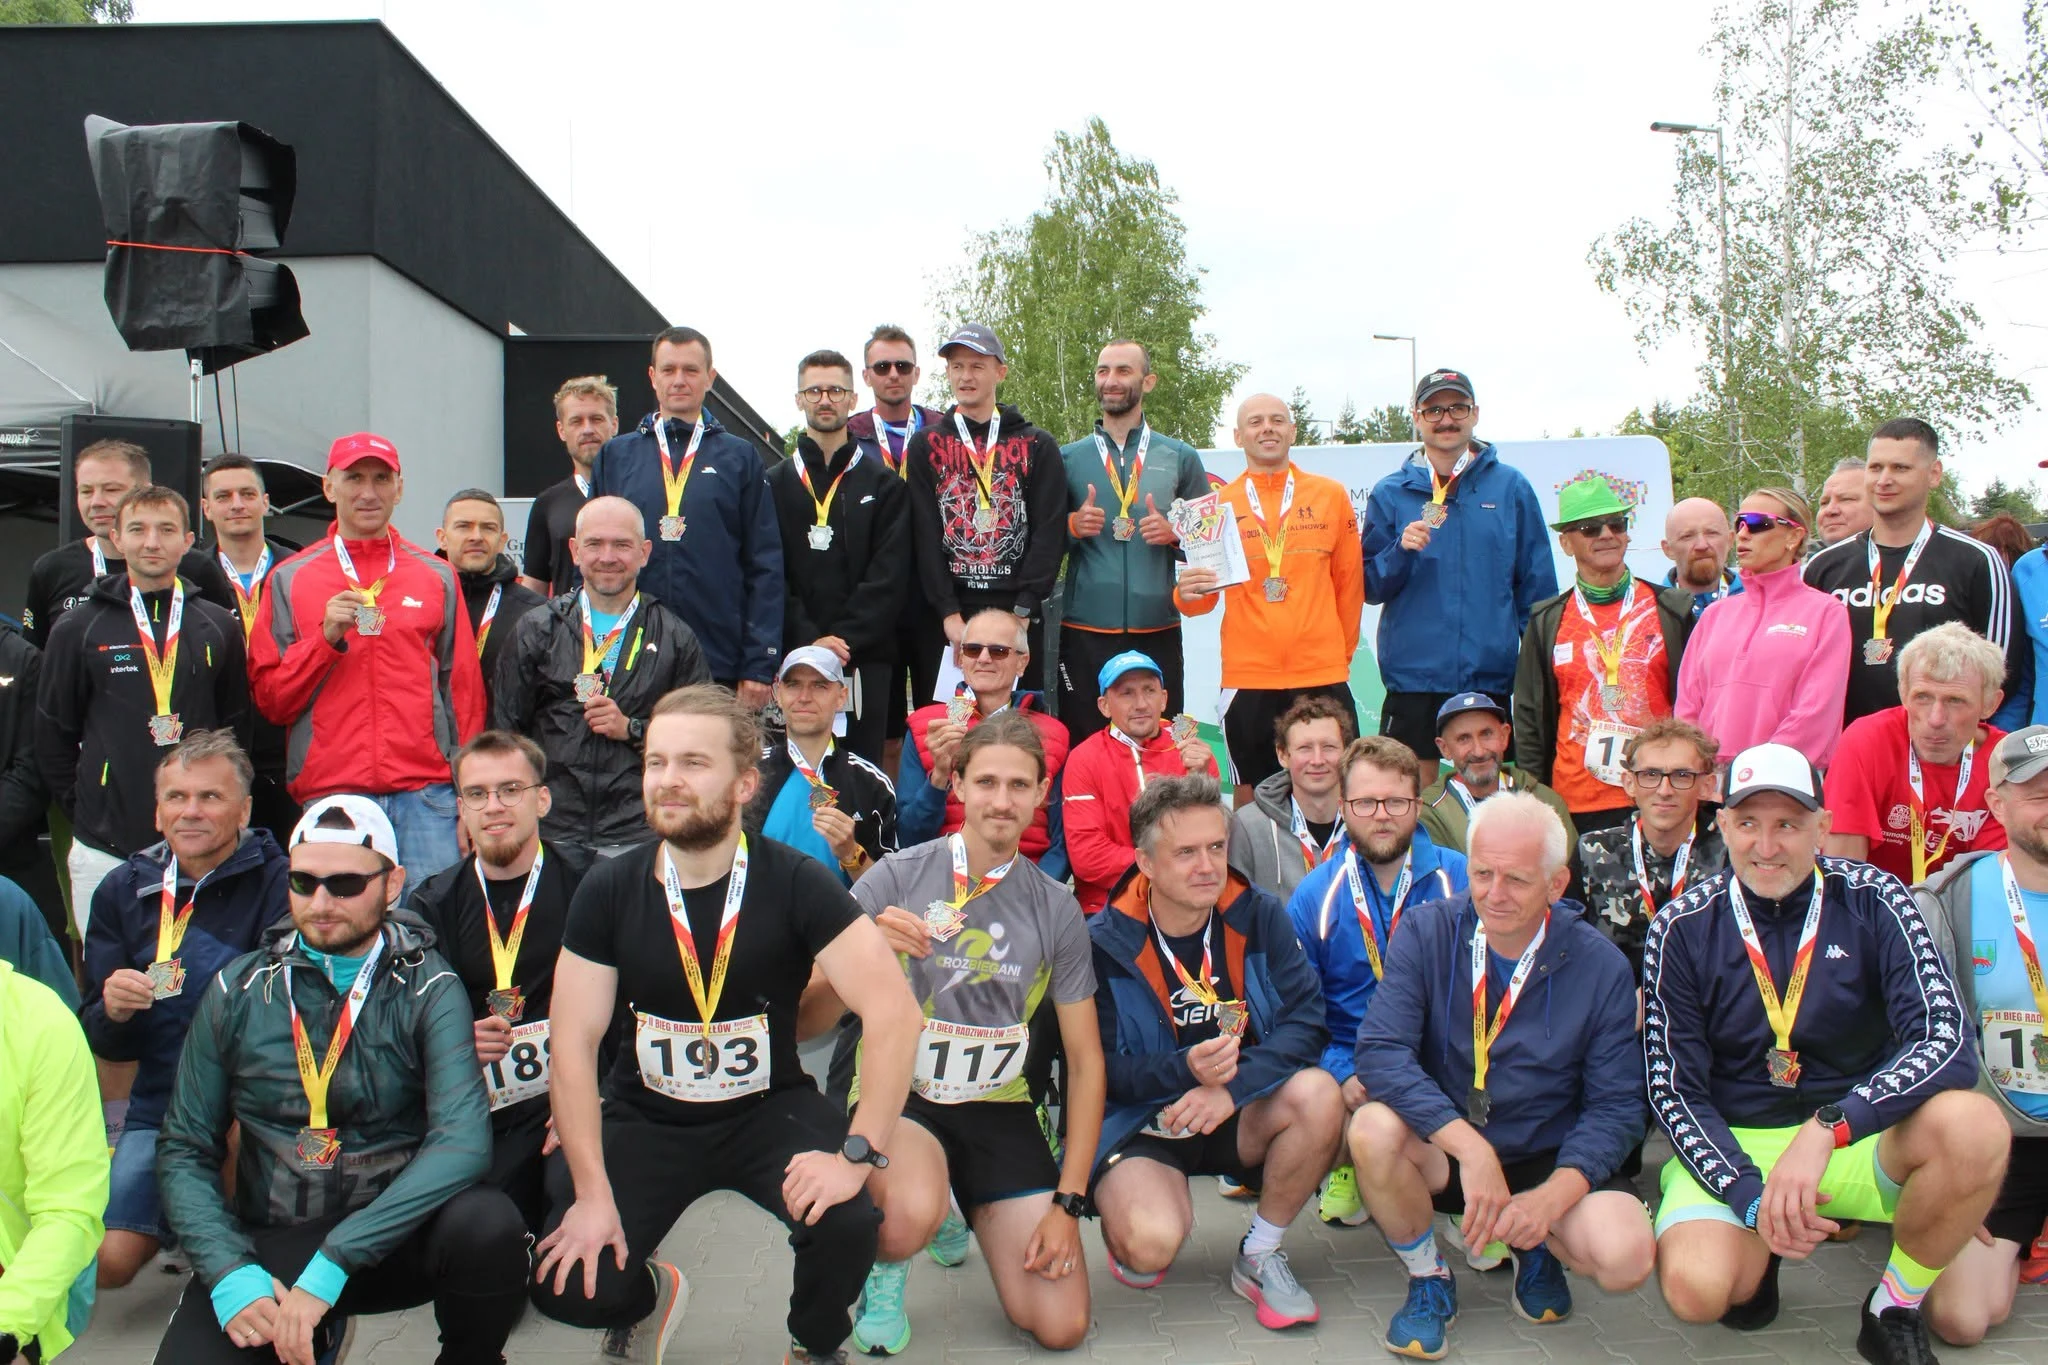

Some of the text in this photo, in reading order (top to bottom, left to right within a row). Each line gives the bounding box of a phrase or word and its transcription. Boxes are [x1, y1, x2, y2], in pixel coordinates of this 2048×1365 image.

[2004, 1011, 2022, 1022] BIEG
[655, 1019, 671, 1031] BIEG
[673, 1022, 731, 1034] RADZIWŁŁÓW
[936, 1022, 953, 1034] BIEG
[955, 1025, 1006, 1039] RADZIWIŁŁÓW
[650, 1036, 759, 1081] 193
[928, 1040, 1021, 1083] 117
